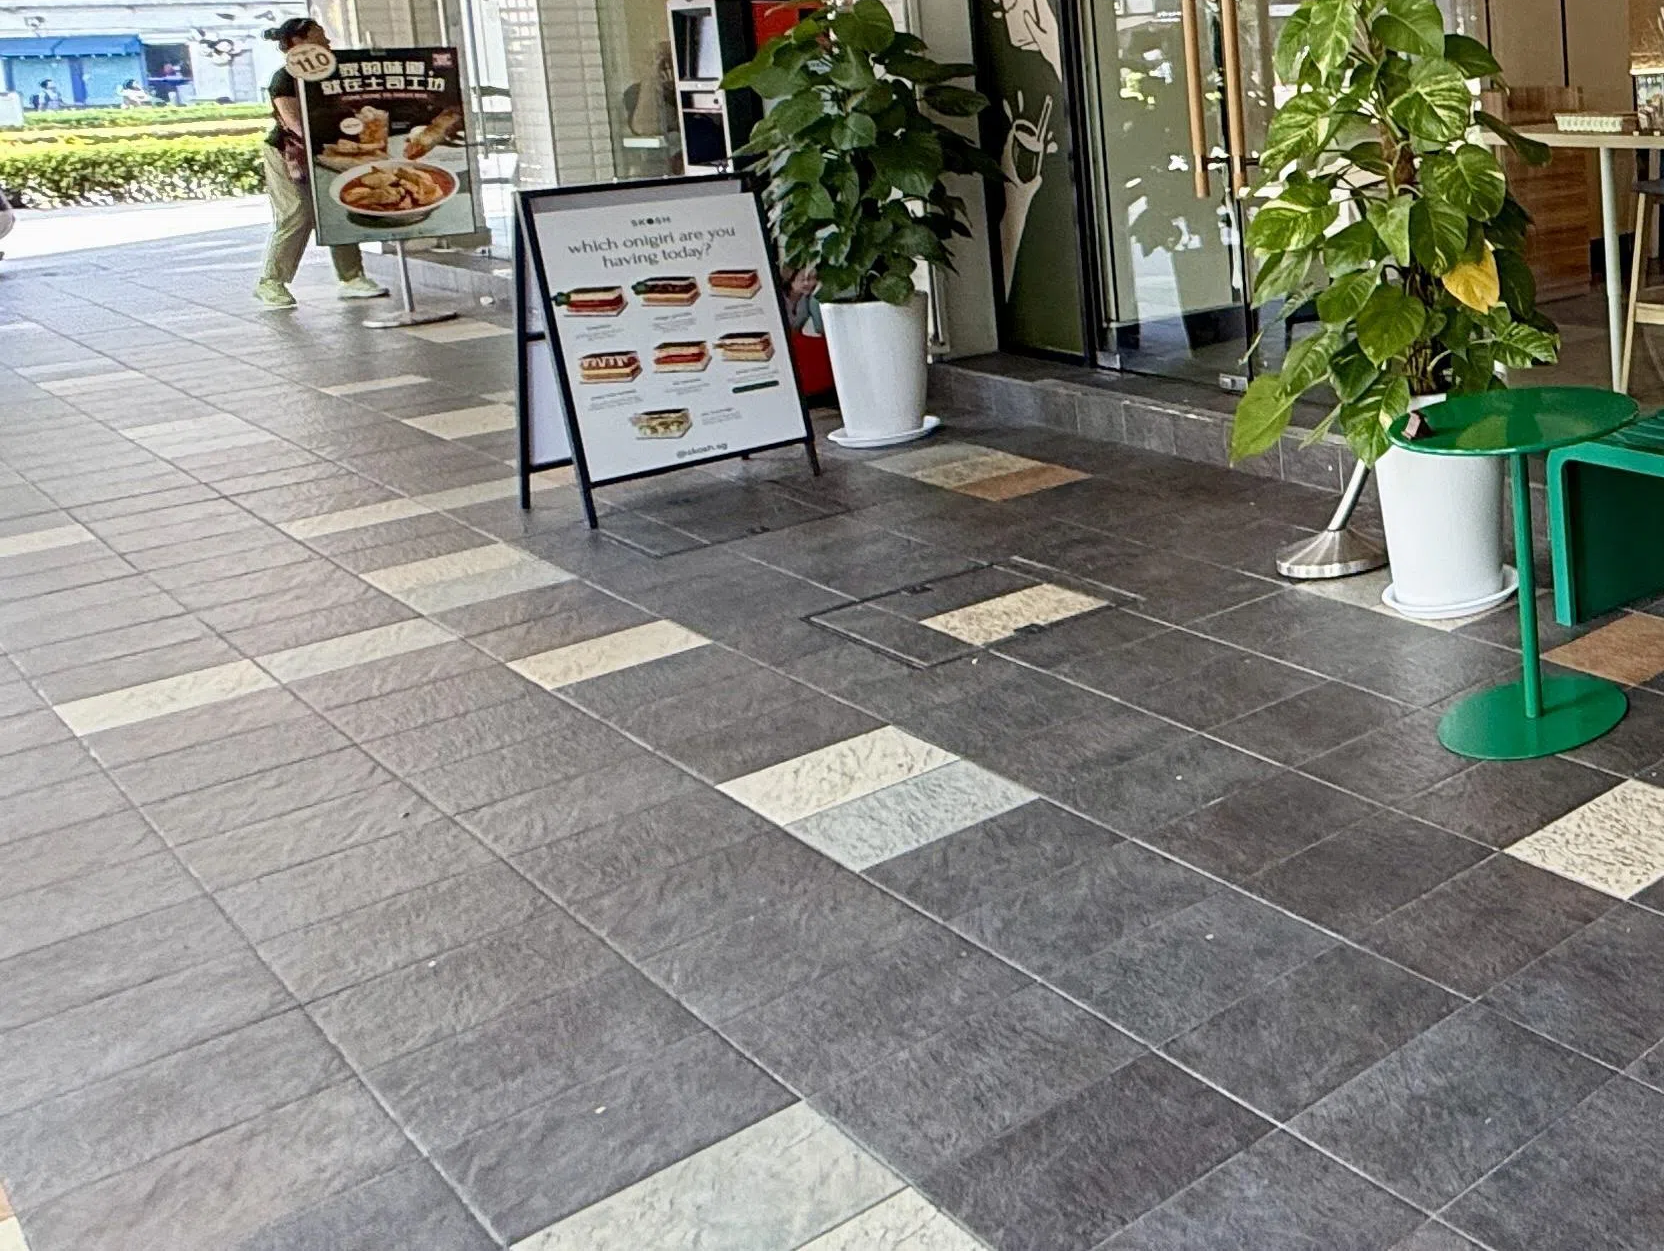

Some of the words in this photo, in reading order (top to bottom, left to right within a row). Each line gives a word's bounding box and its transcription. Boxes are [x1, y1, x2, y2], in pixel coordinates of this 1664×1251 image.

[568, 236, 619, 255] which
[622, 231, 675, 249] onigiri
[679, 230, 704, 243] are
[707, 226, 736, 242] you
[602, 251, 660, 269] having
[662, 243, 713, 262] today?
